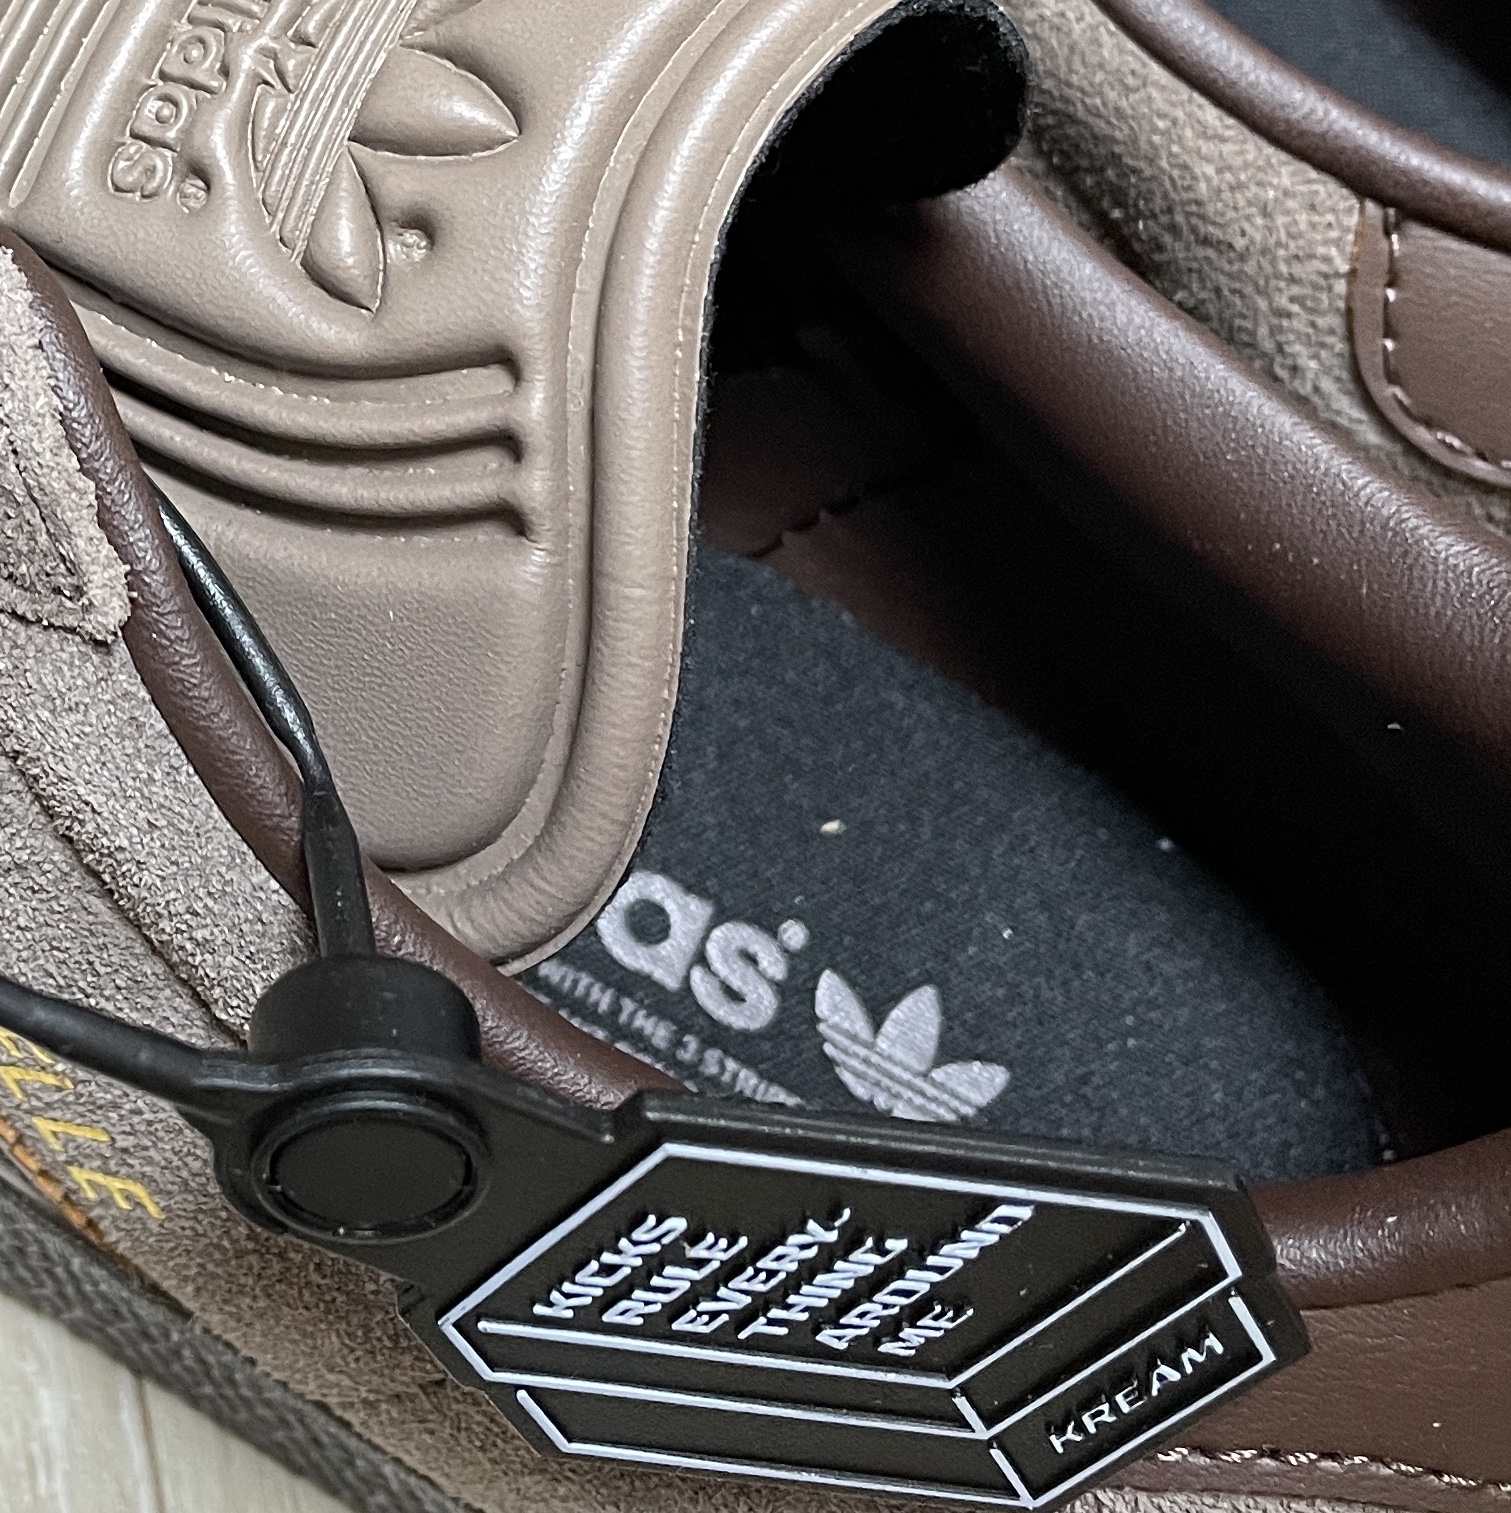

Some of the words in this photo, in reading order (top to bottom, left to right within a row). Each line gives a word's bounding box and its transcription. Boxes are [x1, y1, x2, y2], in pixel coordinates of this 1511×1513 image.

[618, 997, 678, 1050] THE
[675, 1034, 701, 1064] 3
[532, 1214, 688, 1320] KICKS
[601, 1232, 749, 1326] RULE
[737, 1236, 909, 1341] THING
[815, 1203, 1037, 1350] AROUND
[877, 1303, 975, 1357] ME
[1048, 1330, 1225, 1455] KREAM
